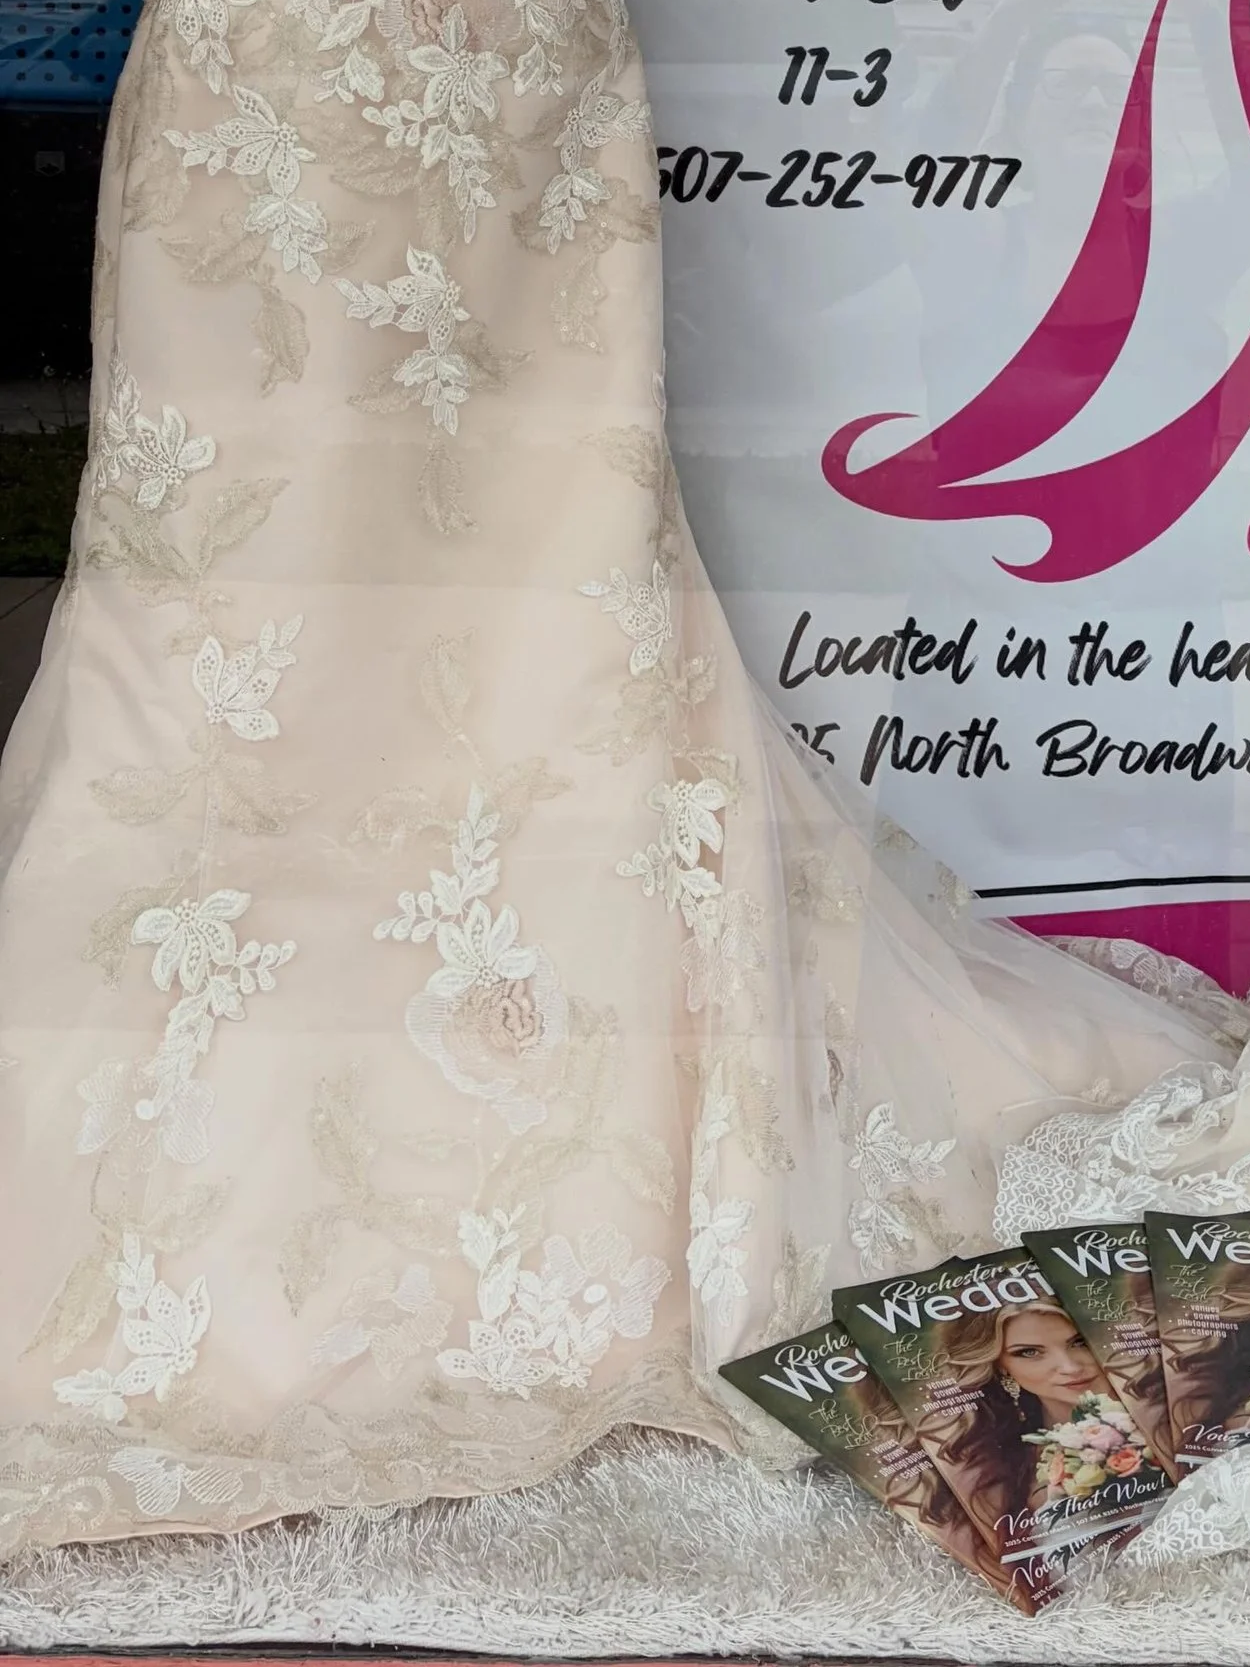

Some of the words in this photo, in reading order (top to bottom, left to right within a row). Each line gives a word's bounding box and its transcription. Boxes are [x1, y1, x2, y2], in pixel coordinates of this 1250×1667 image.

[778, 46, 892, 108] 11-3
[778, 610, 979, 690] Located
[996, 626, 1047, 681] in
[1067, 621, 1152, 686] the
[859, 715, 1010, 787] North
[880, 1263, 1004, 1304] Rochester
[1190, 1304, 1220, 1314] venues
[1193, 1313, 1220, 1322] gowns
[1177, 1318, 1239, 1331] photographers
[1191, 1328, 1227, 1338] catering
[774, 1332, 854, 1370] Roche
[760, 1348, 869, 1402] We
[926, 1377, 957, 1390] venues
[922, 1389, 985, 1412] photographers
[933, 1385, 962, 1399] gowns
[941, 1402, 978, 1417] catering
[1053, 1491, 1105, 1521] That
[1103, 1472, 1166, 1504] Wow!
